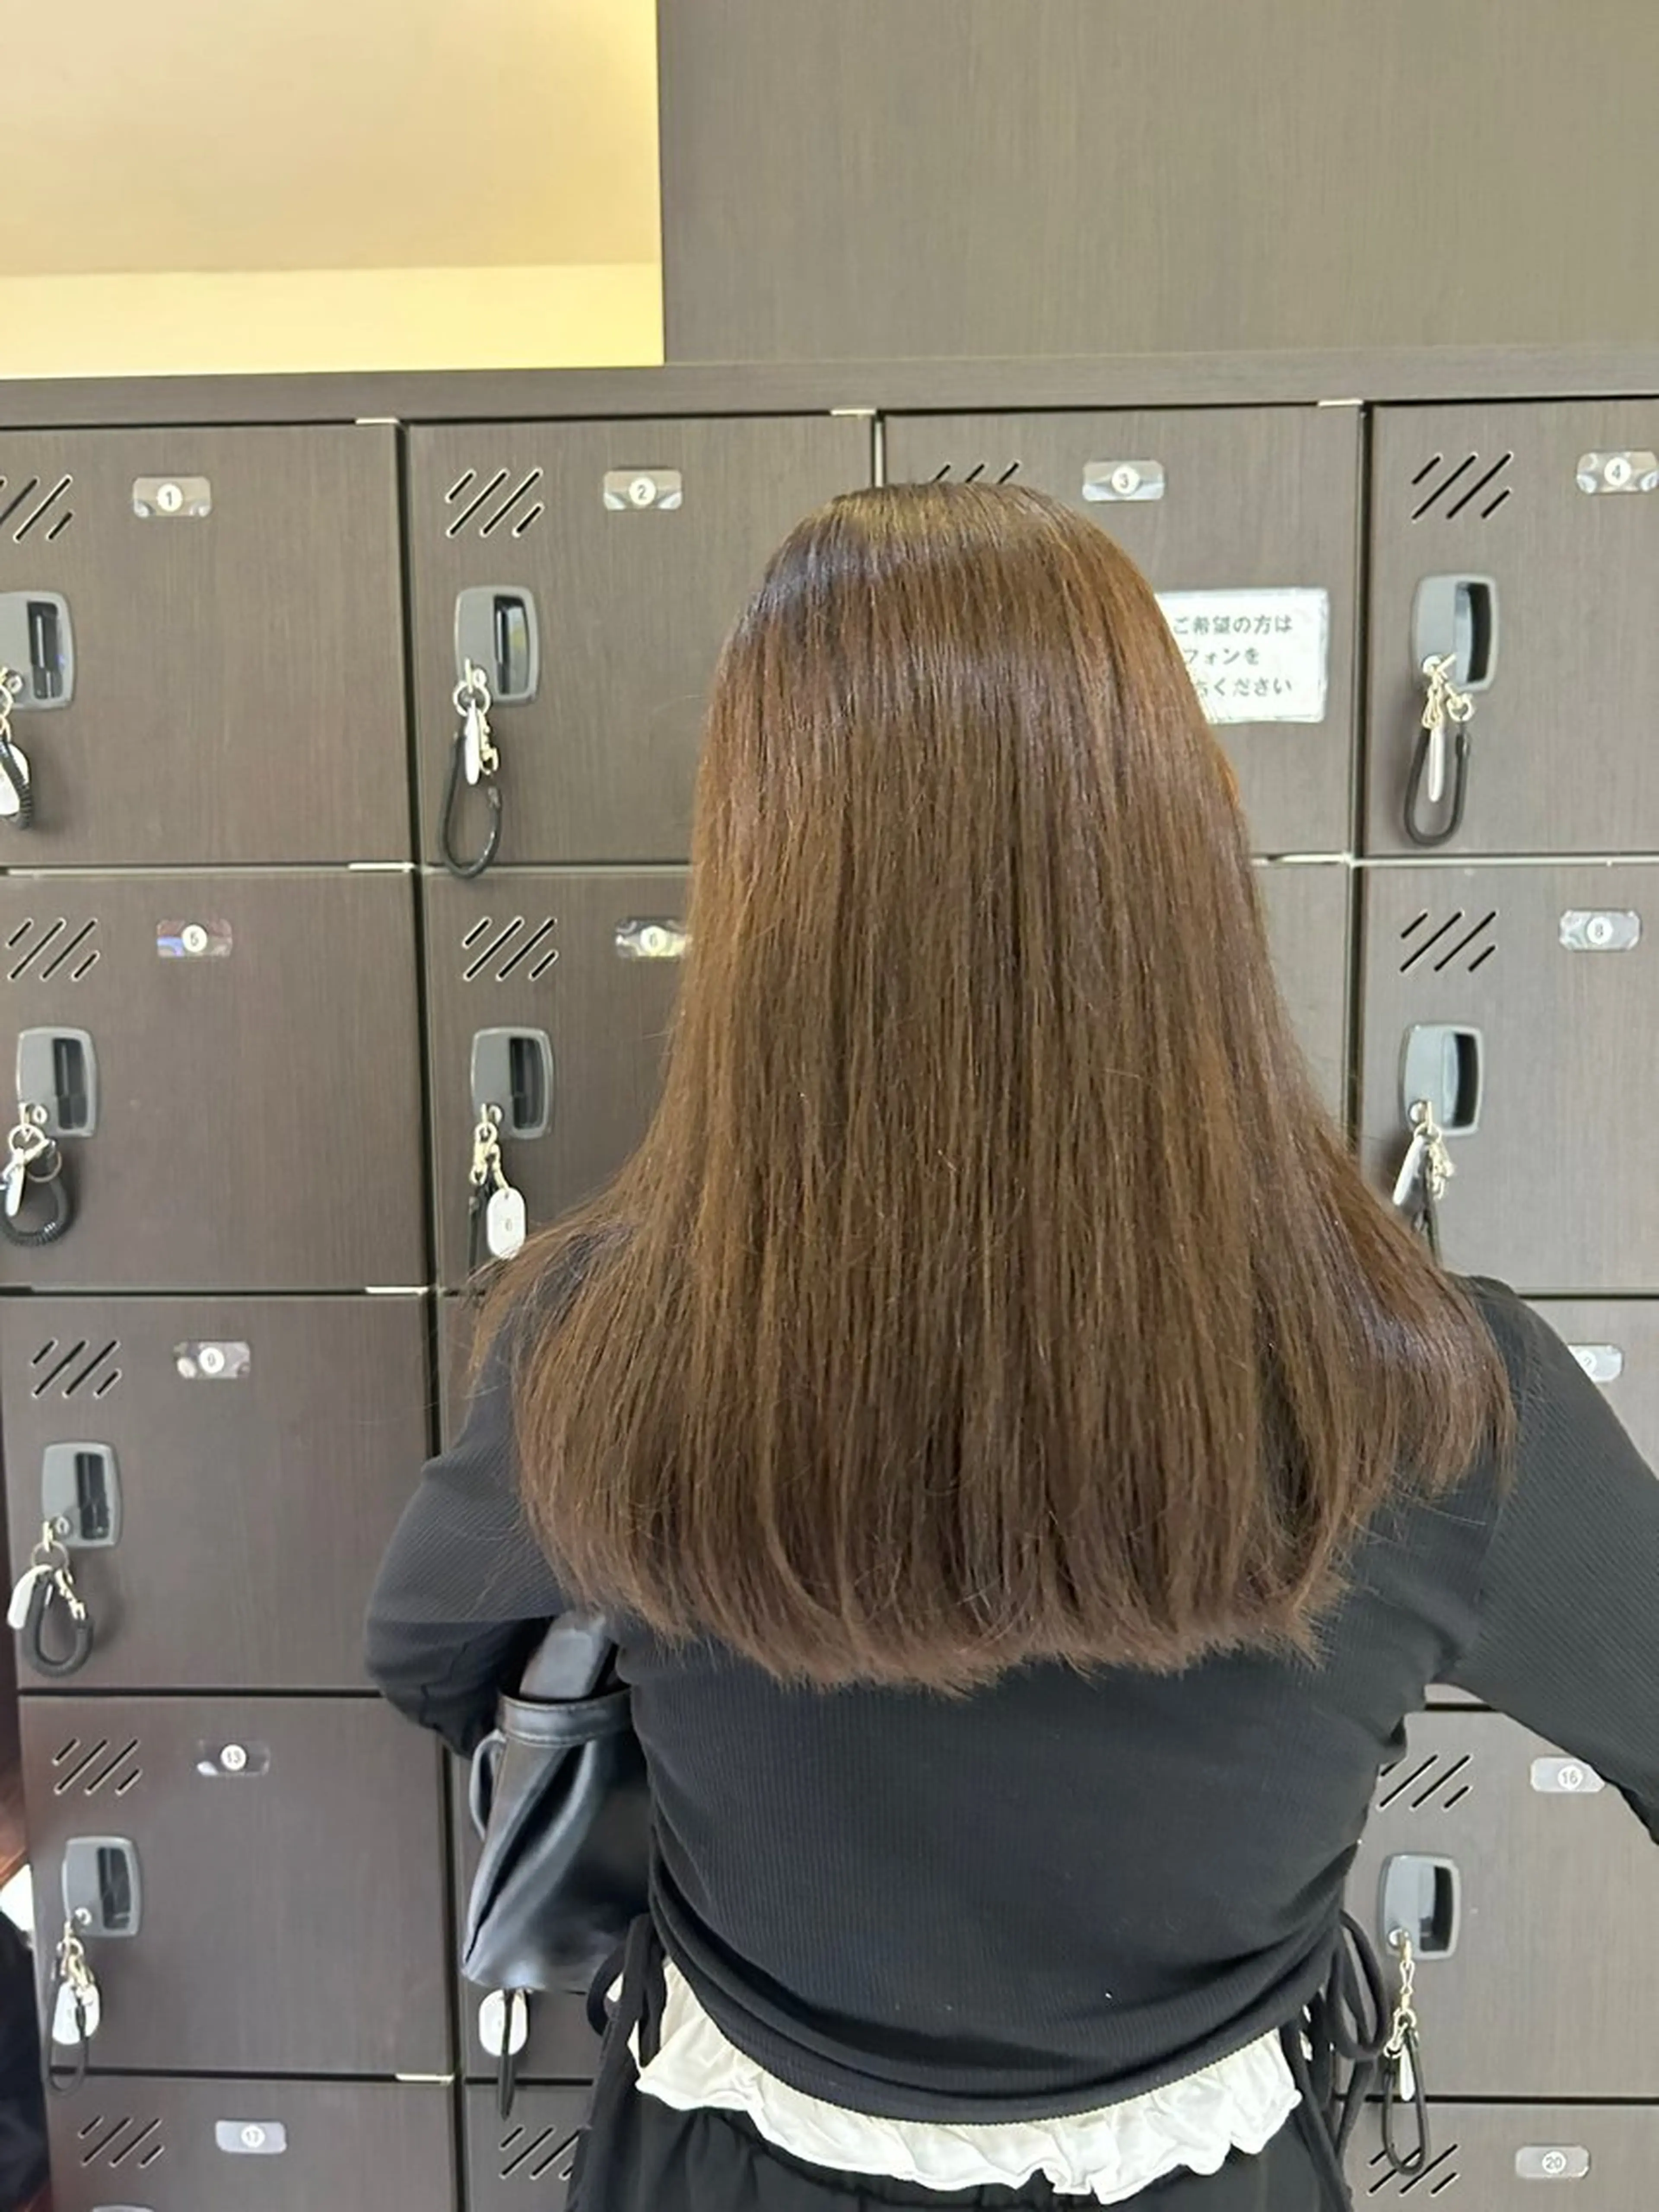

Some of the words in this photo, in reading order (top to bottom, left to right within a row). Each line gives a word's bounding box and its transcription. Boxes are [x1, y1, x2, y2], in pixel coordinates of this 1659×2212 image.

[1612, 464, 1621, 480] 4
[1119, 473, 1129, 488] 3
[166, 491, 172, 506] 1
[638, 484, 647, 499] 2
[1173, 614, 1293, 635] ご希望の方は
[1562, 1770, 1578, 1785] 16
[1545, 2156, 1562, 2170] 20
